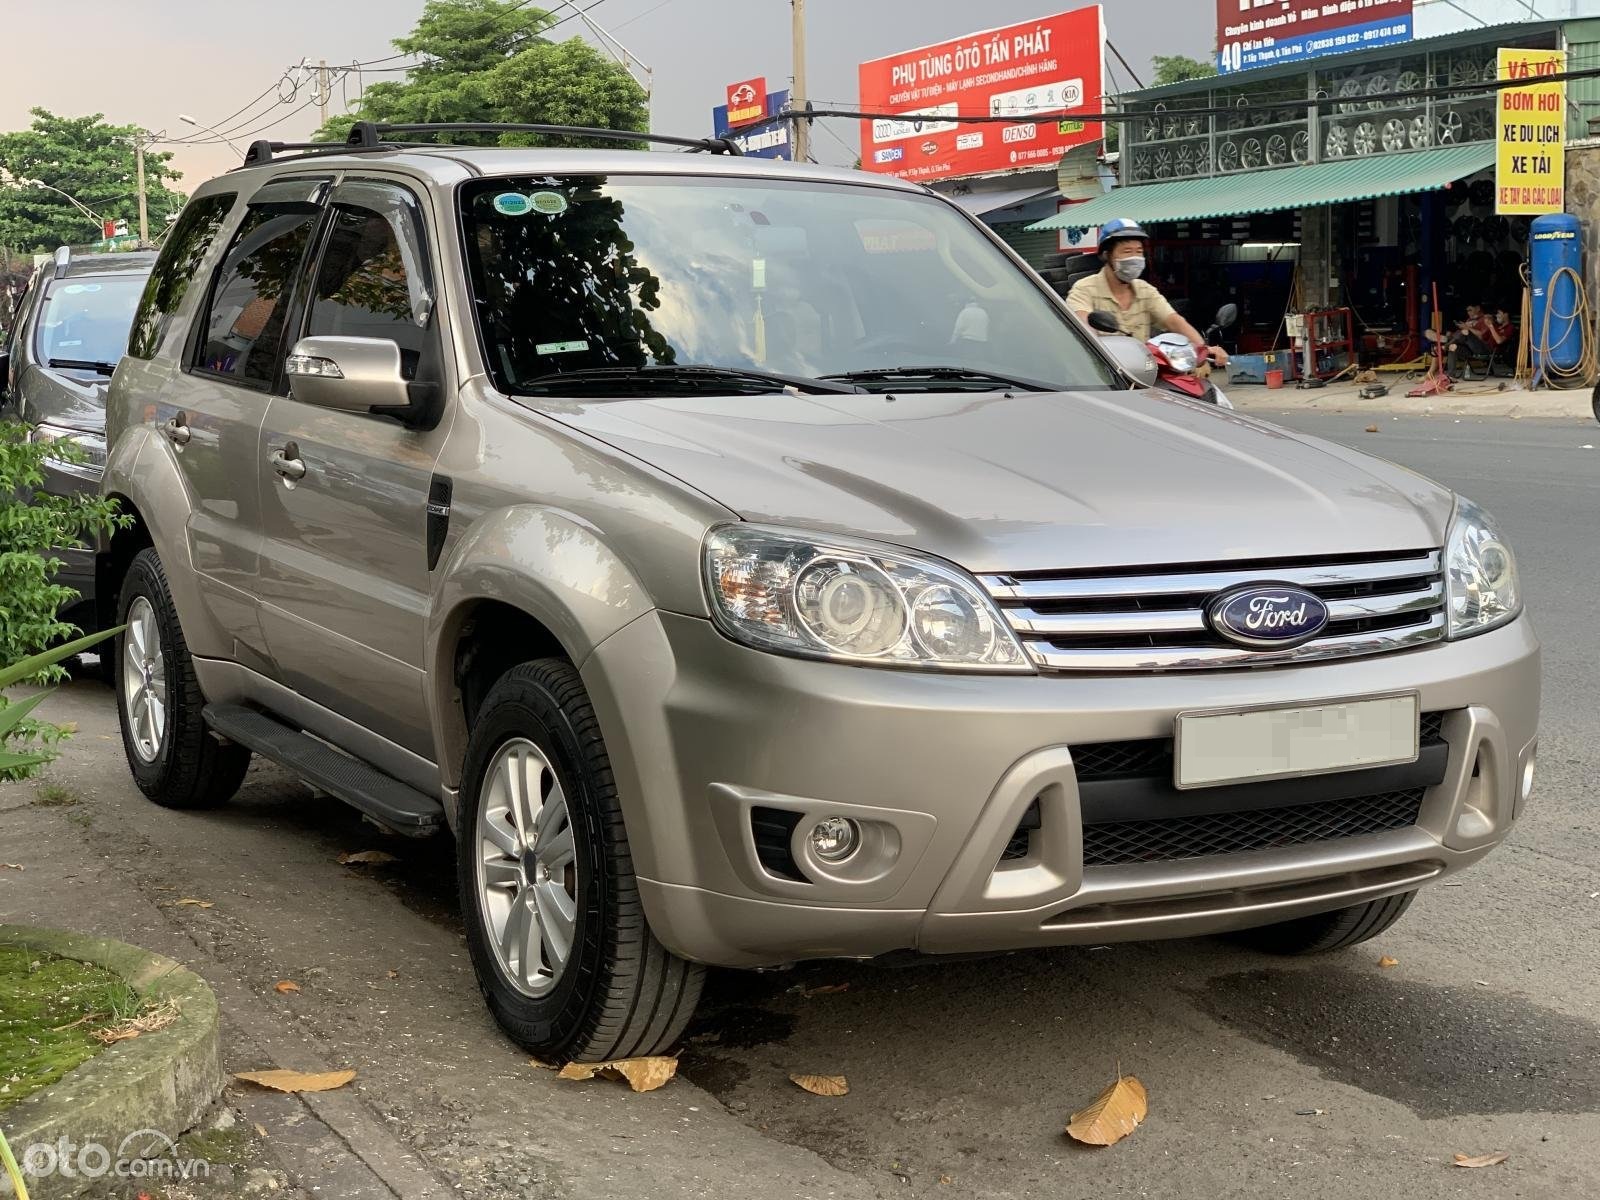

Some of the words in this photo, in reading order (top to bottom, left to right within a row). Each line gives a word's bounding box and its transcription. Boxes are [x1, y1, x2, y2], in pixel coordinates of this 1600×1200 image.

[892, 63, 916, 87] PHỤ
[919, 53, 953, 80] TÙNG
[955, 42, 981, 71] ÔTÔ
[983, 33, 1010, 65] TẤN
[1014, 26, 1052, 58] PHÁT
[1221, 42, 1241, 71] 40
[1503, 91, 1533, 111] BƠM
[1538, 92, 1560, 111] HƠI
[1004, 125, 1035, 141] DENSO
[1503, 124, 1516, 142] XE
[1520, 124, 1534, 142] DU
[1537, 125, 1560, 146] LỊCH
[881, 149, 902, 161] SANDEN
[1511, 156, 1528, 173] XE
[1532, 150, 1551, 173] TẢI
[1500, 187, 1508, 205] XE
[1510, 187, 1520, 205] TAY
[1522, 187, 1531, 205] GA
[1245, 597, 1308, 629] Ford
